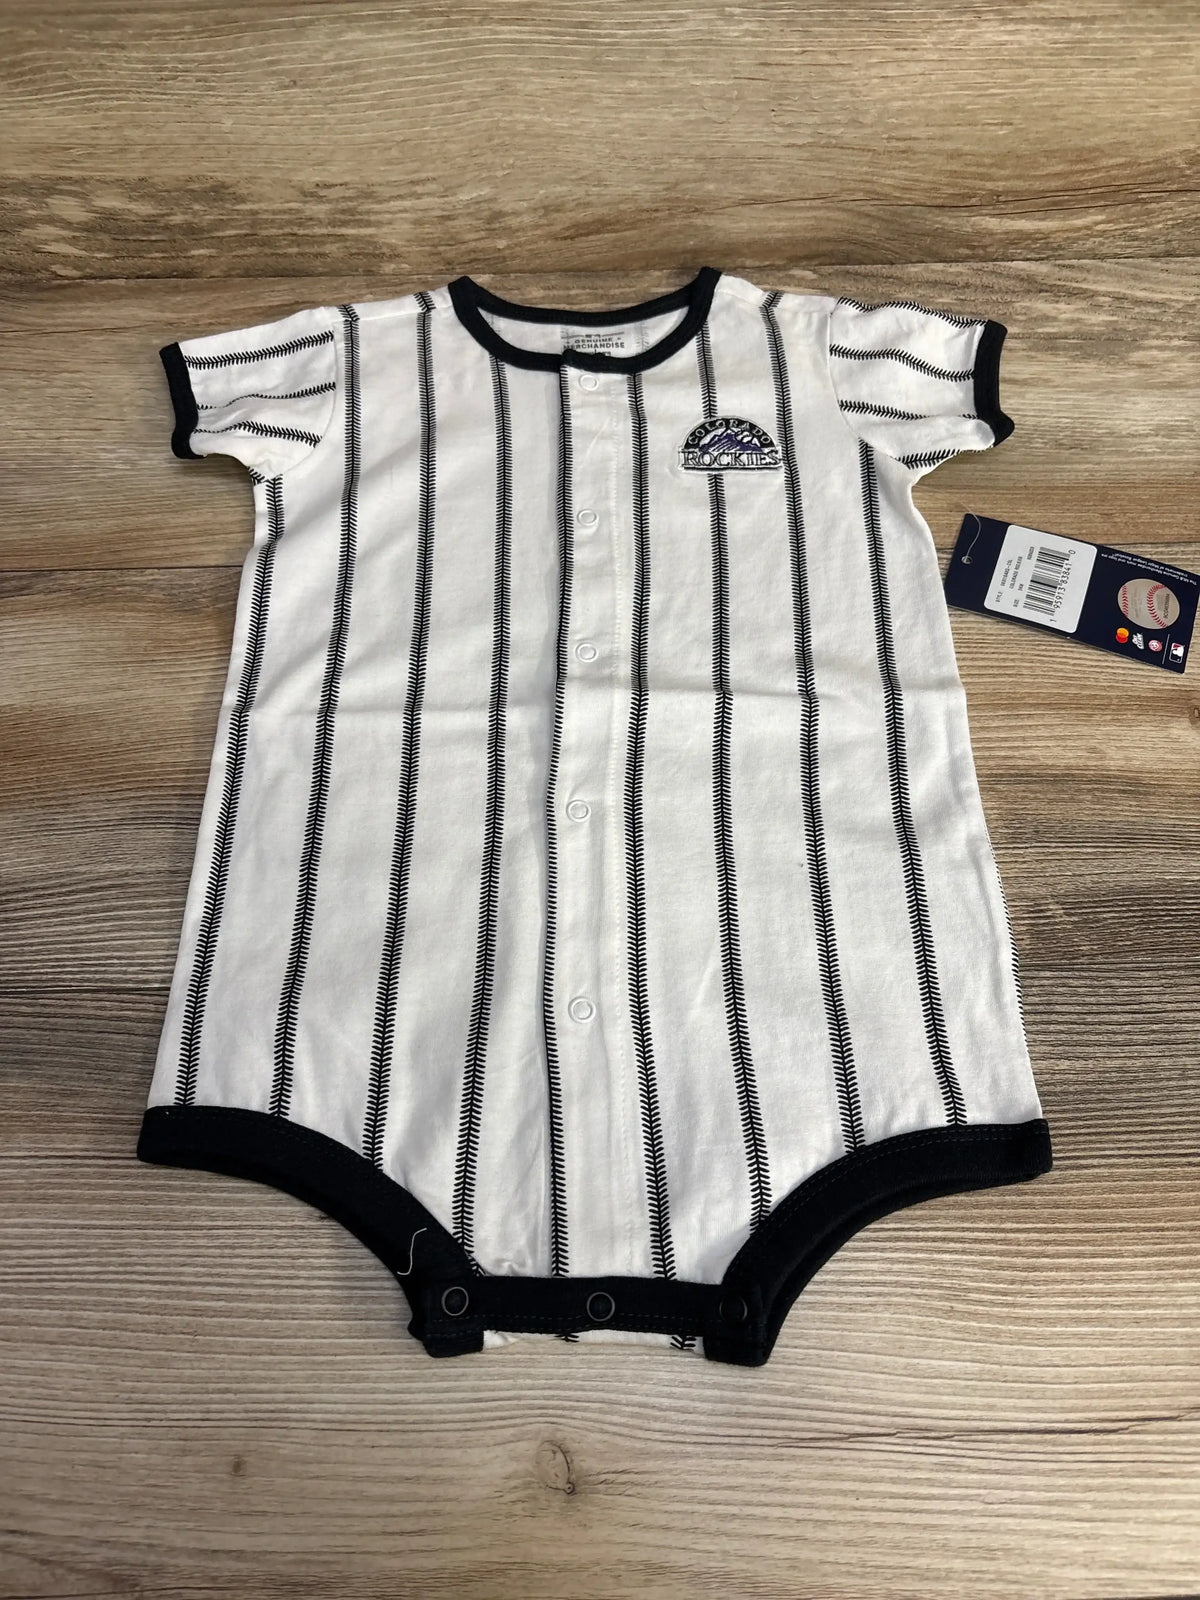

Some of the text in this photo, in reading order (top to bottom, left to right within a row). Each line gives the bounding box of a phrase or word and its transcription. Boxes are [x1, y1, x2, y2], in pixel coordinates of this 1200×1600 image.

[688, 419, 772, 445] COLORADO
[678, 448, 783, 467] ROCKIES
[1053, 587, 1066, 609] 95913
[1060, 563, 1072, 584] 83841
